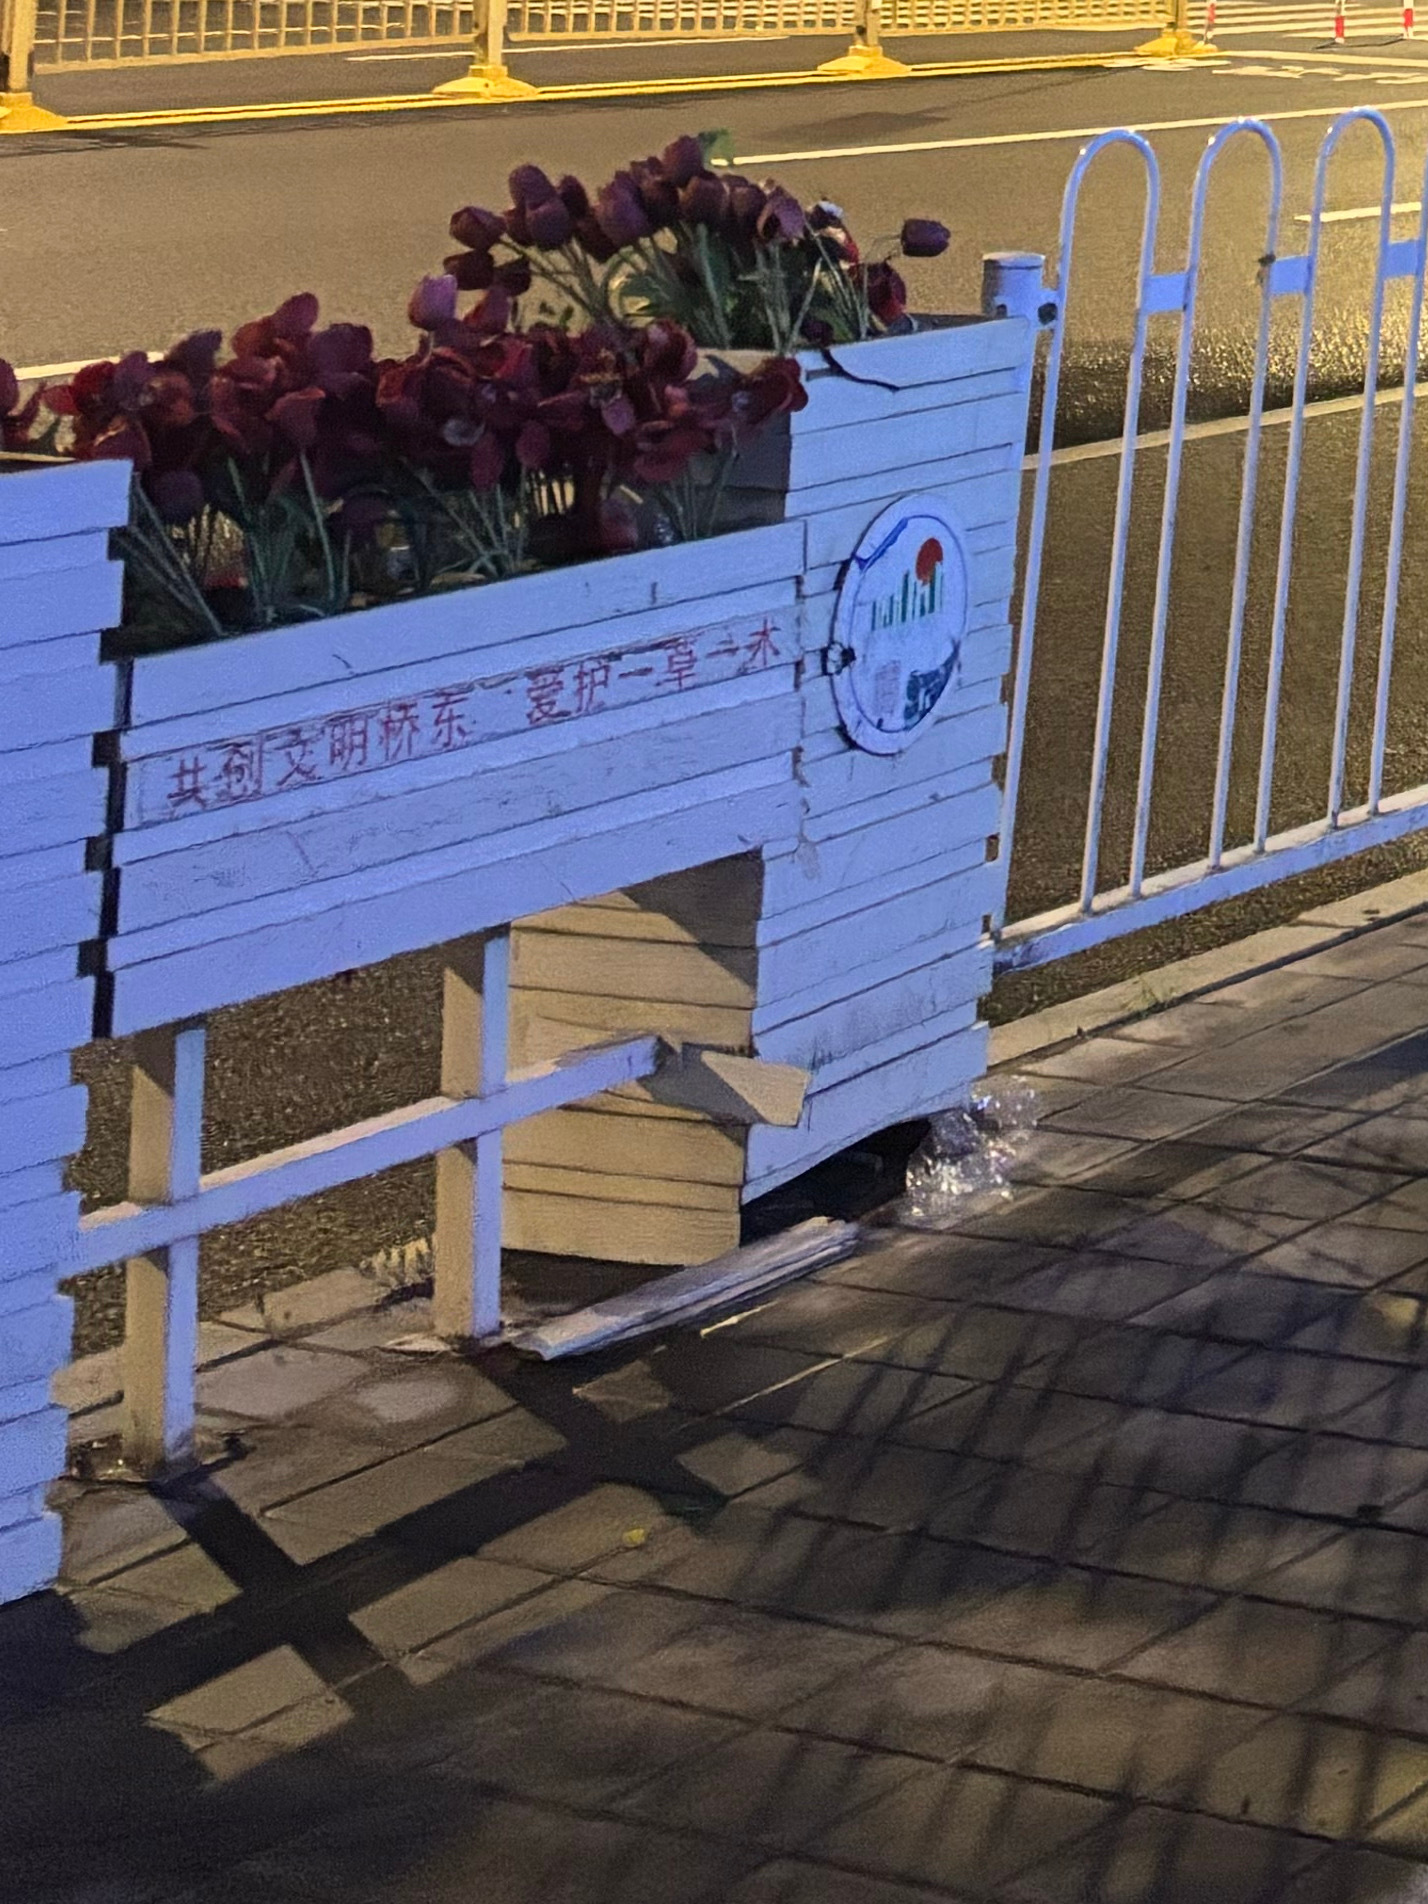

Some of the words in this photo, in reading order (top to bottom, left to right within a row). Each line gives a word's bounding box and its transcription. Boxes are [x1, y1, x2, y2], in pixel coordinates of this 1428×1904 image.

[166, 691, 470, 809] 共创文明桥东
[525, 617, 782, 725] 爱护一草一木
